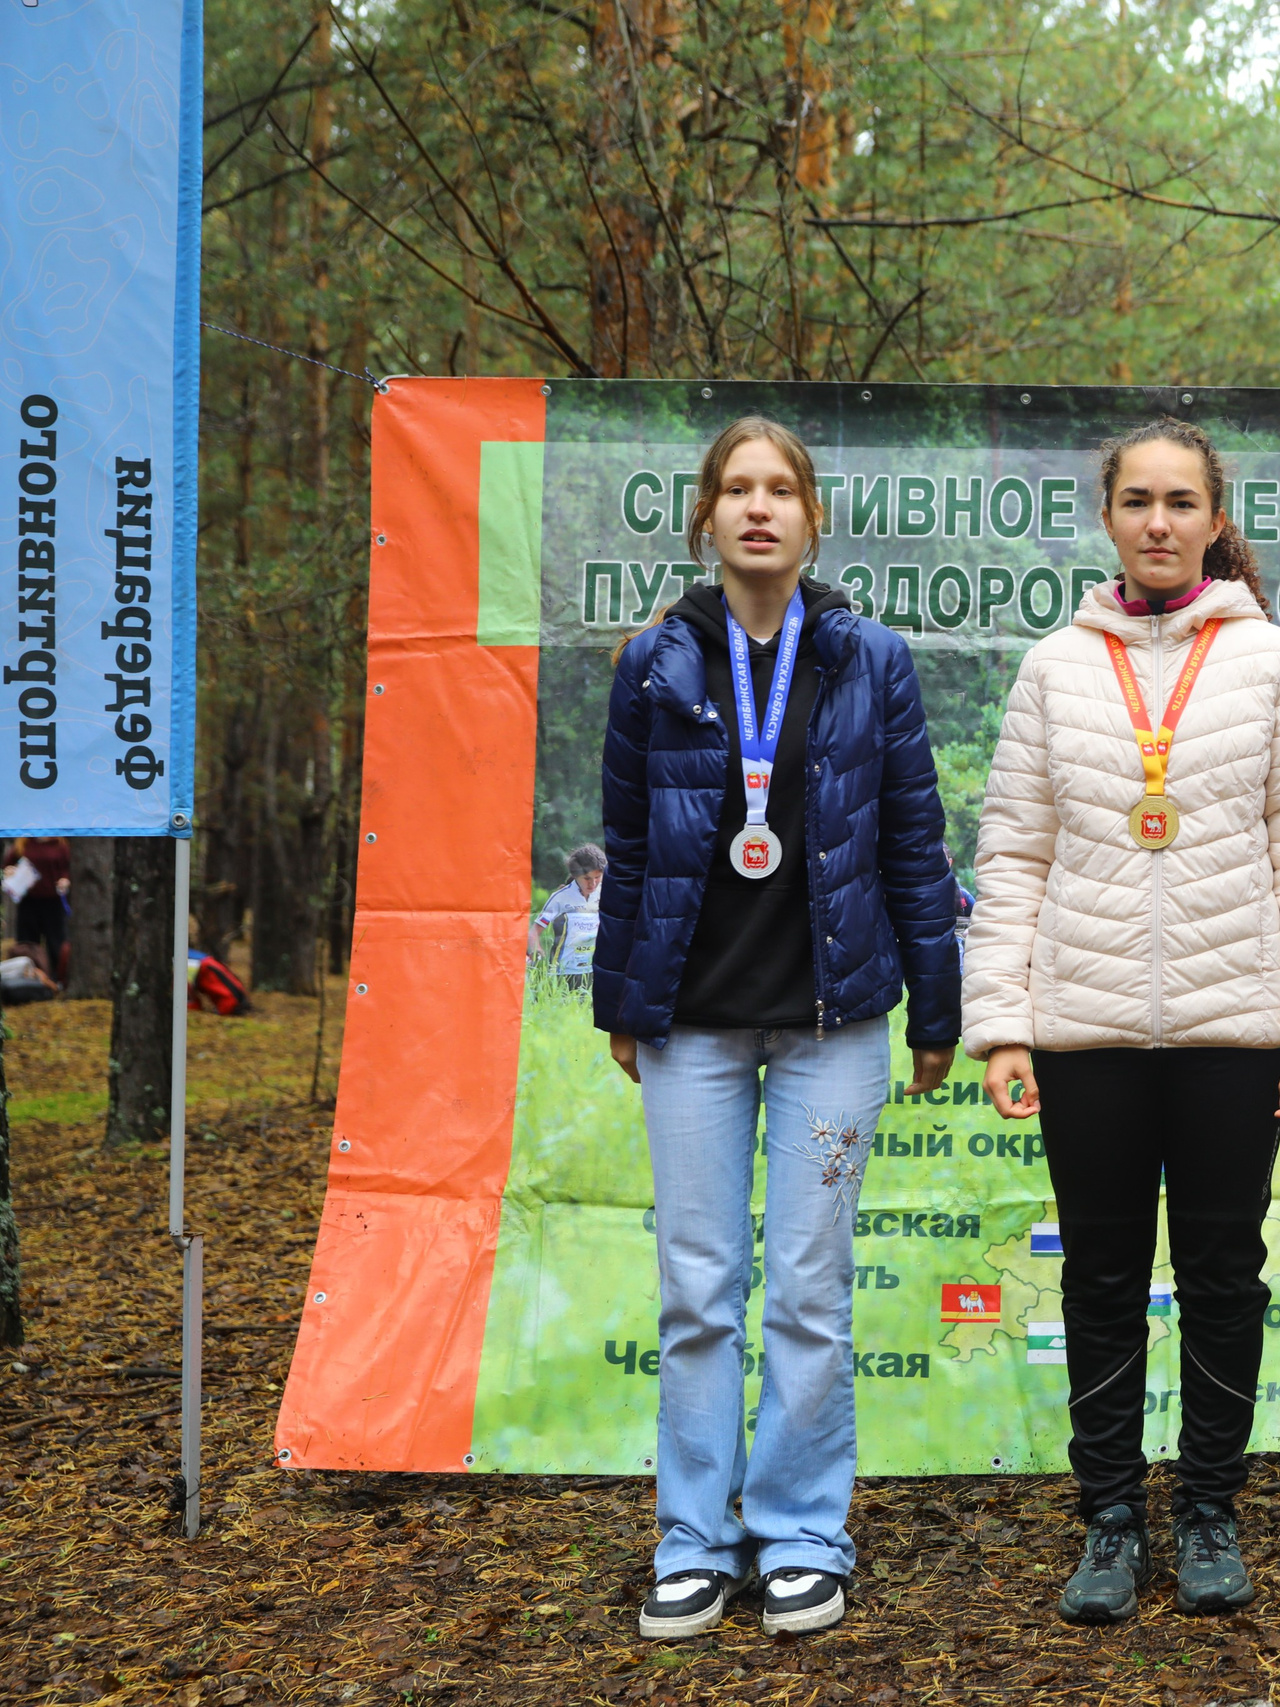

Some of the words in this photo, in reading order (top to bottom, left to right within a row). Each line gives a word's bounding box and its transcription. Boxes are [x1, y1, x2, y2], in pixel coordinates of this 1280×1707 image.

[584, 561, 723, 624] ПУТ
[776, 616, 799, 691] ЧЕЛЯБИНСКАЯ
[1115, 648, 1141, 713] ЧЕЛЯБИНСКАЯ
[736, 662, 754, 741] ЧЕЛЯБИНСКАЯ
[766, 692, 785, 741] ОБЛАСТЬ
[1172, 668, 1196, 712] ОБЛАСТЬ
